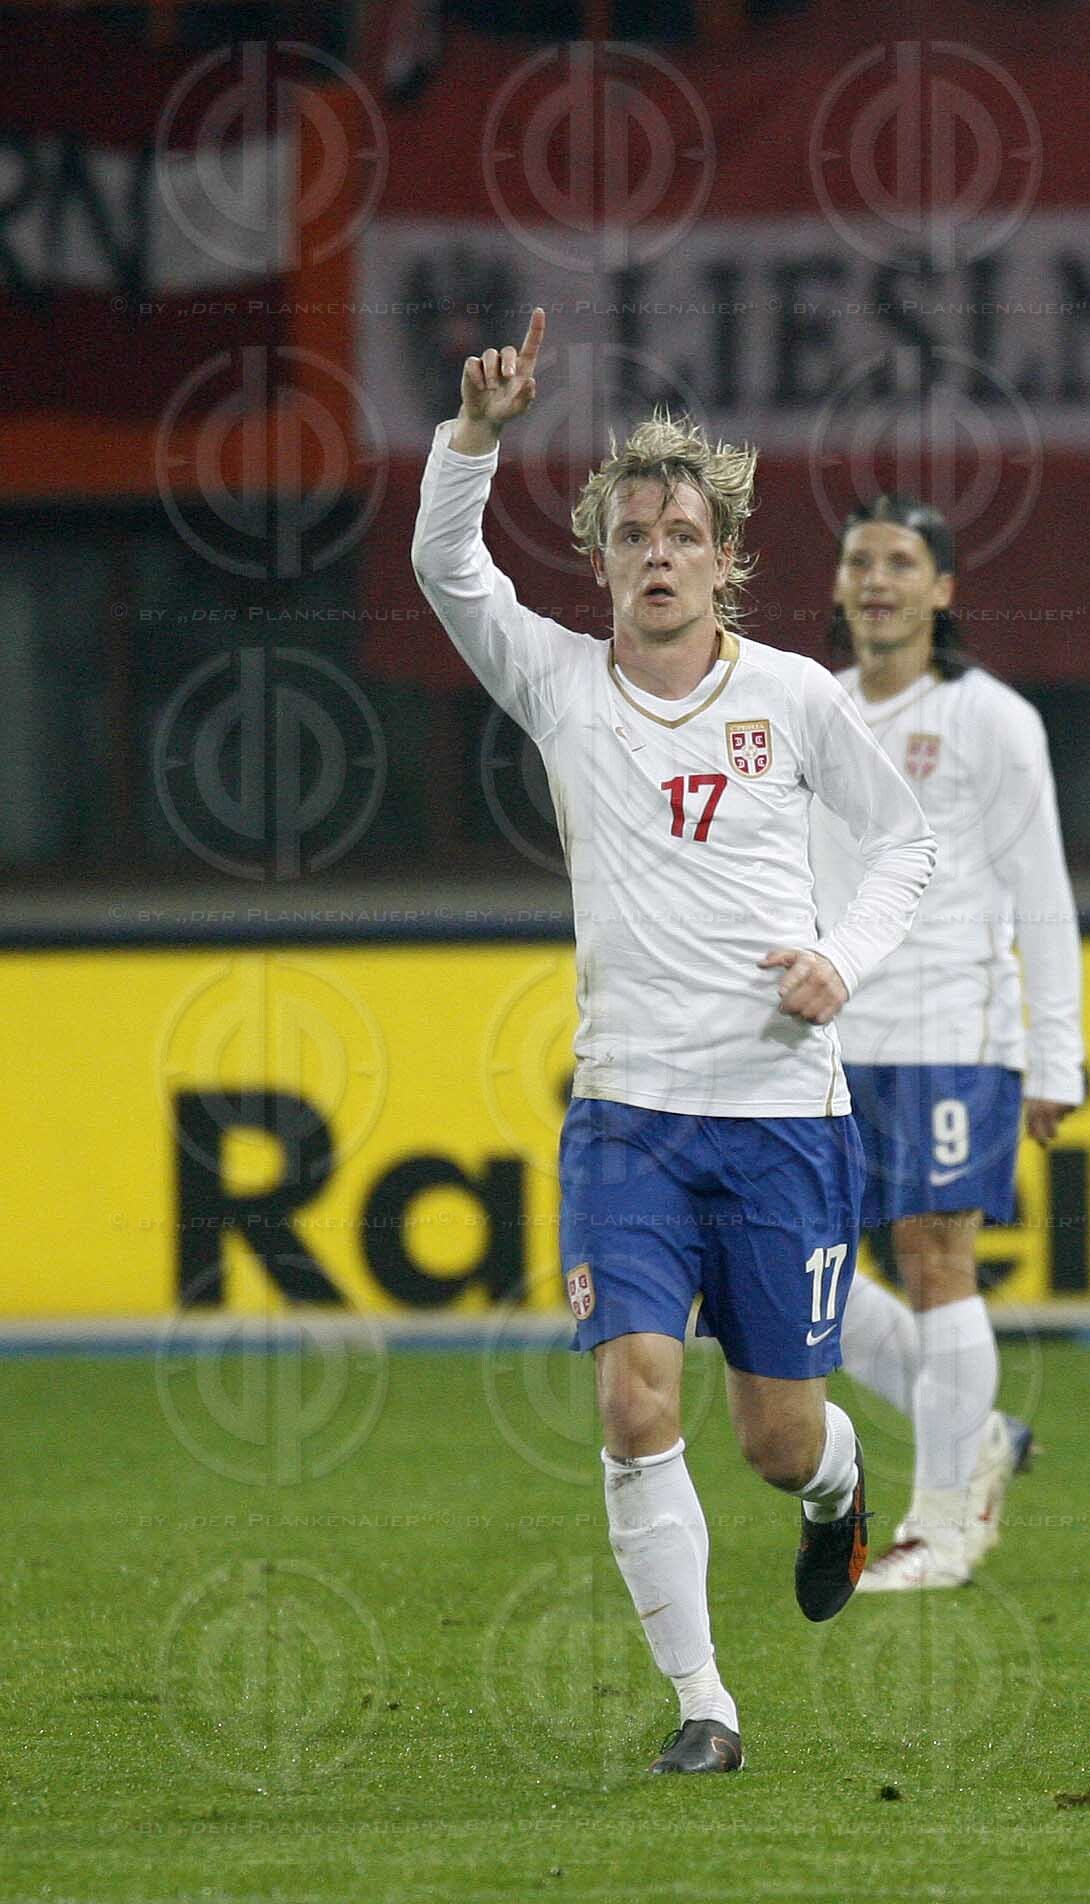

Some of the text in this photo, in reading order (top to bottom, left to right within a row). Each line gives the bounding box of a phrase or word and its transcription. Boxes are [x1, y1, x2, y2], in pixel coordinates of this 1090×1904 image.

[661, 773, 728, 842] 17
[931, 1098, 970, 1166] 9
[806, 1243, 848, 1323] 17
